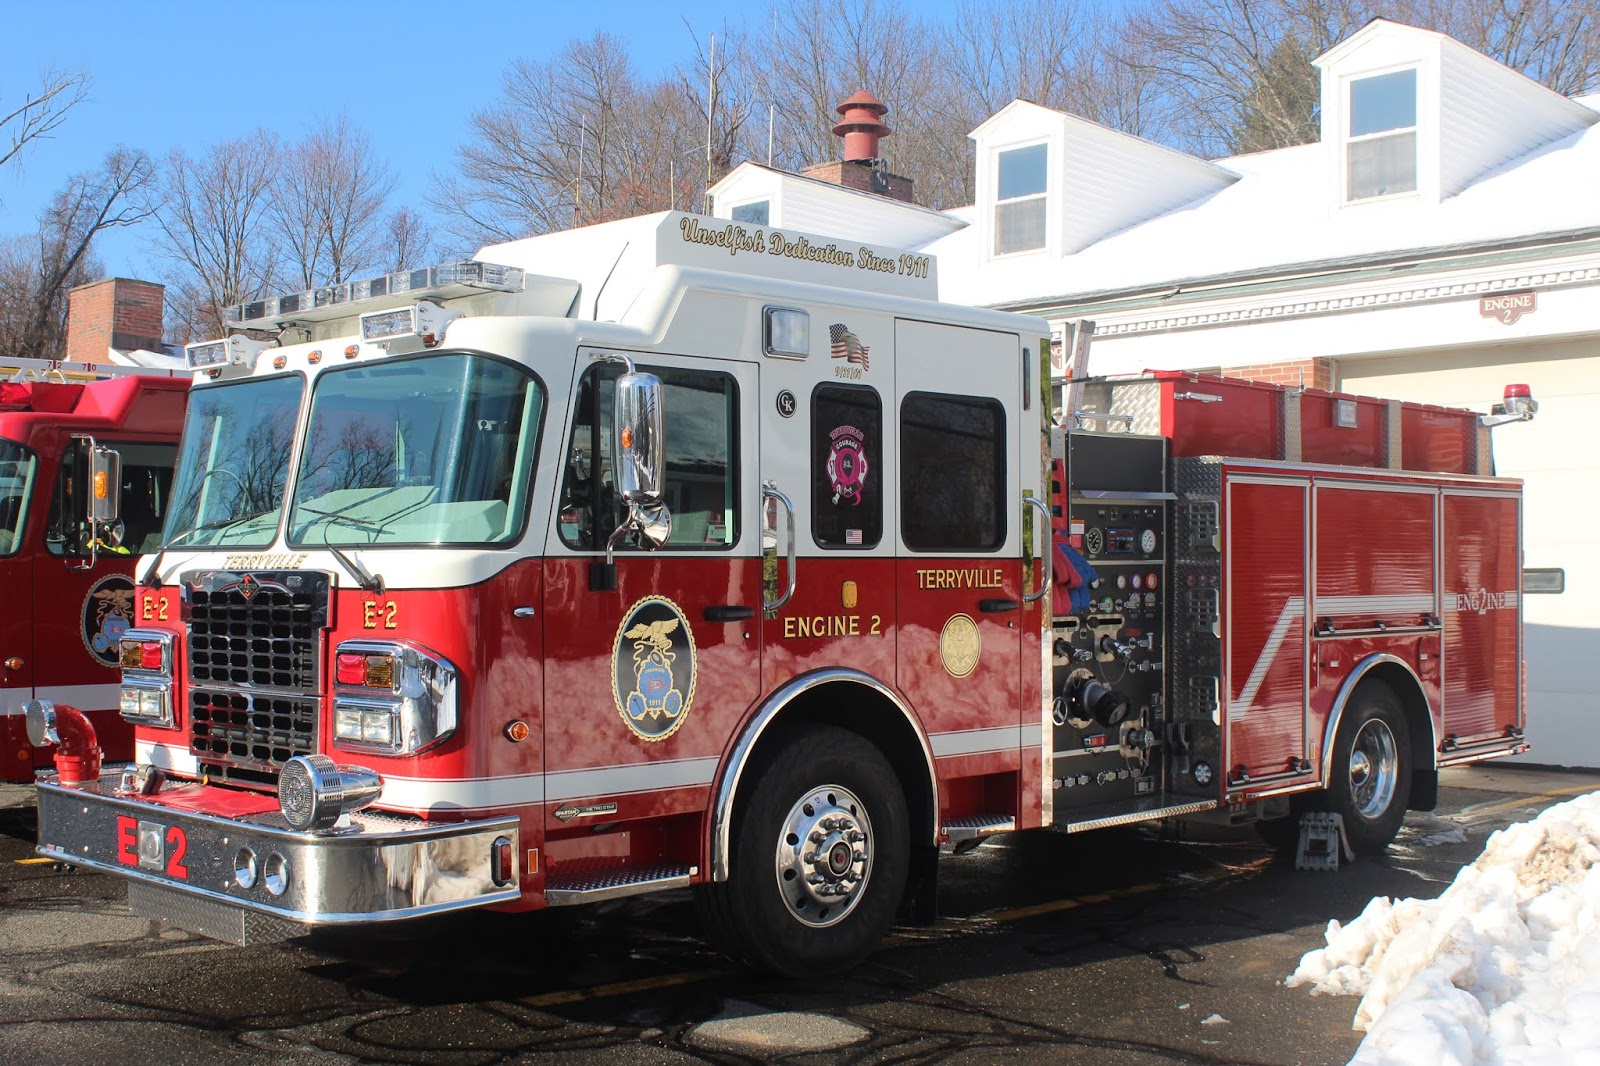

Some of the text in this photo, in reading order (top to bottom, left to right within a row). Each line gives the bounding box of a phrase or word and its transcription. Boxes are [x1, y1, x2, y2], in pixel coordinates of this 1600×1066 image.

[680, 217, 930, 279] Unselfish Dedication Since 1911
[1483, 295, 1532, 311] ENGINE
[1503, 309, 1512, 323] 2
[836, 439, 859, 450] COURAGE
[221, 553, 309, 570] TERRYVILLE
[916, 569, 1003, 589] TERRYVILLE
[143, 596, 169, 620] E-2
[363, 600, 398, 630] E-2
[783, 614, 882, 639] ENGINE 2
[117, 815, 188, 879] E 2
